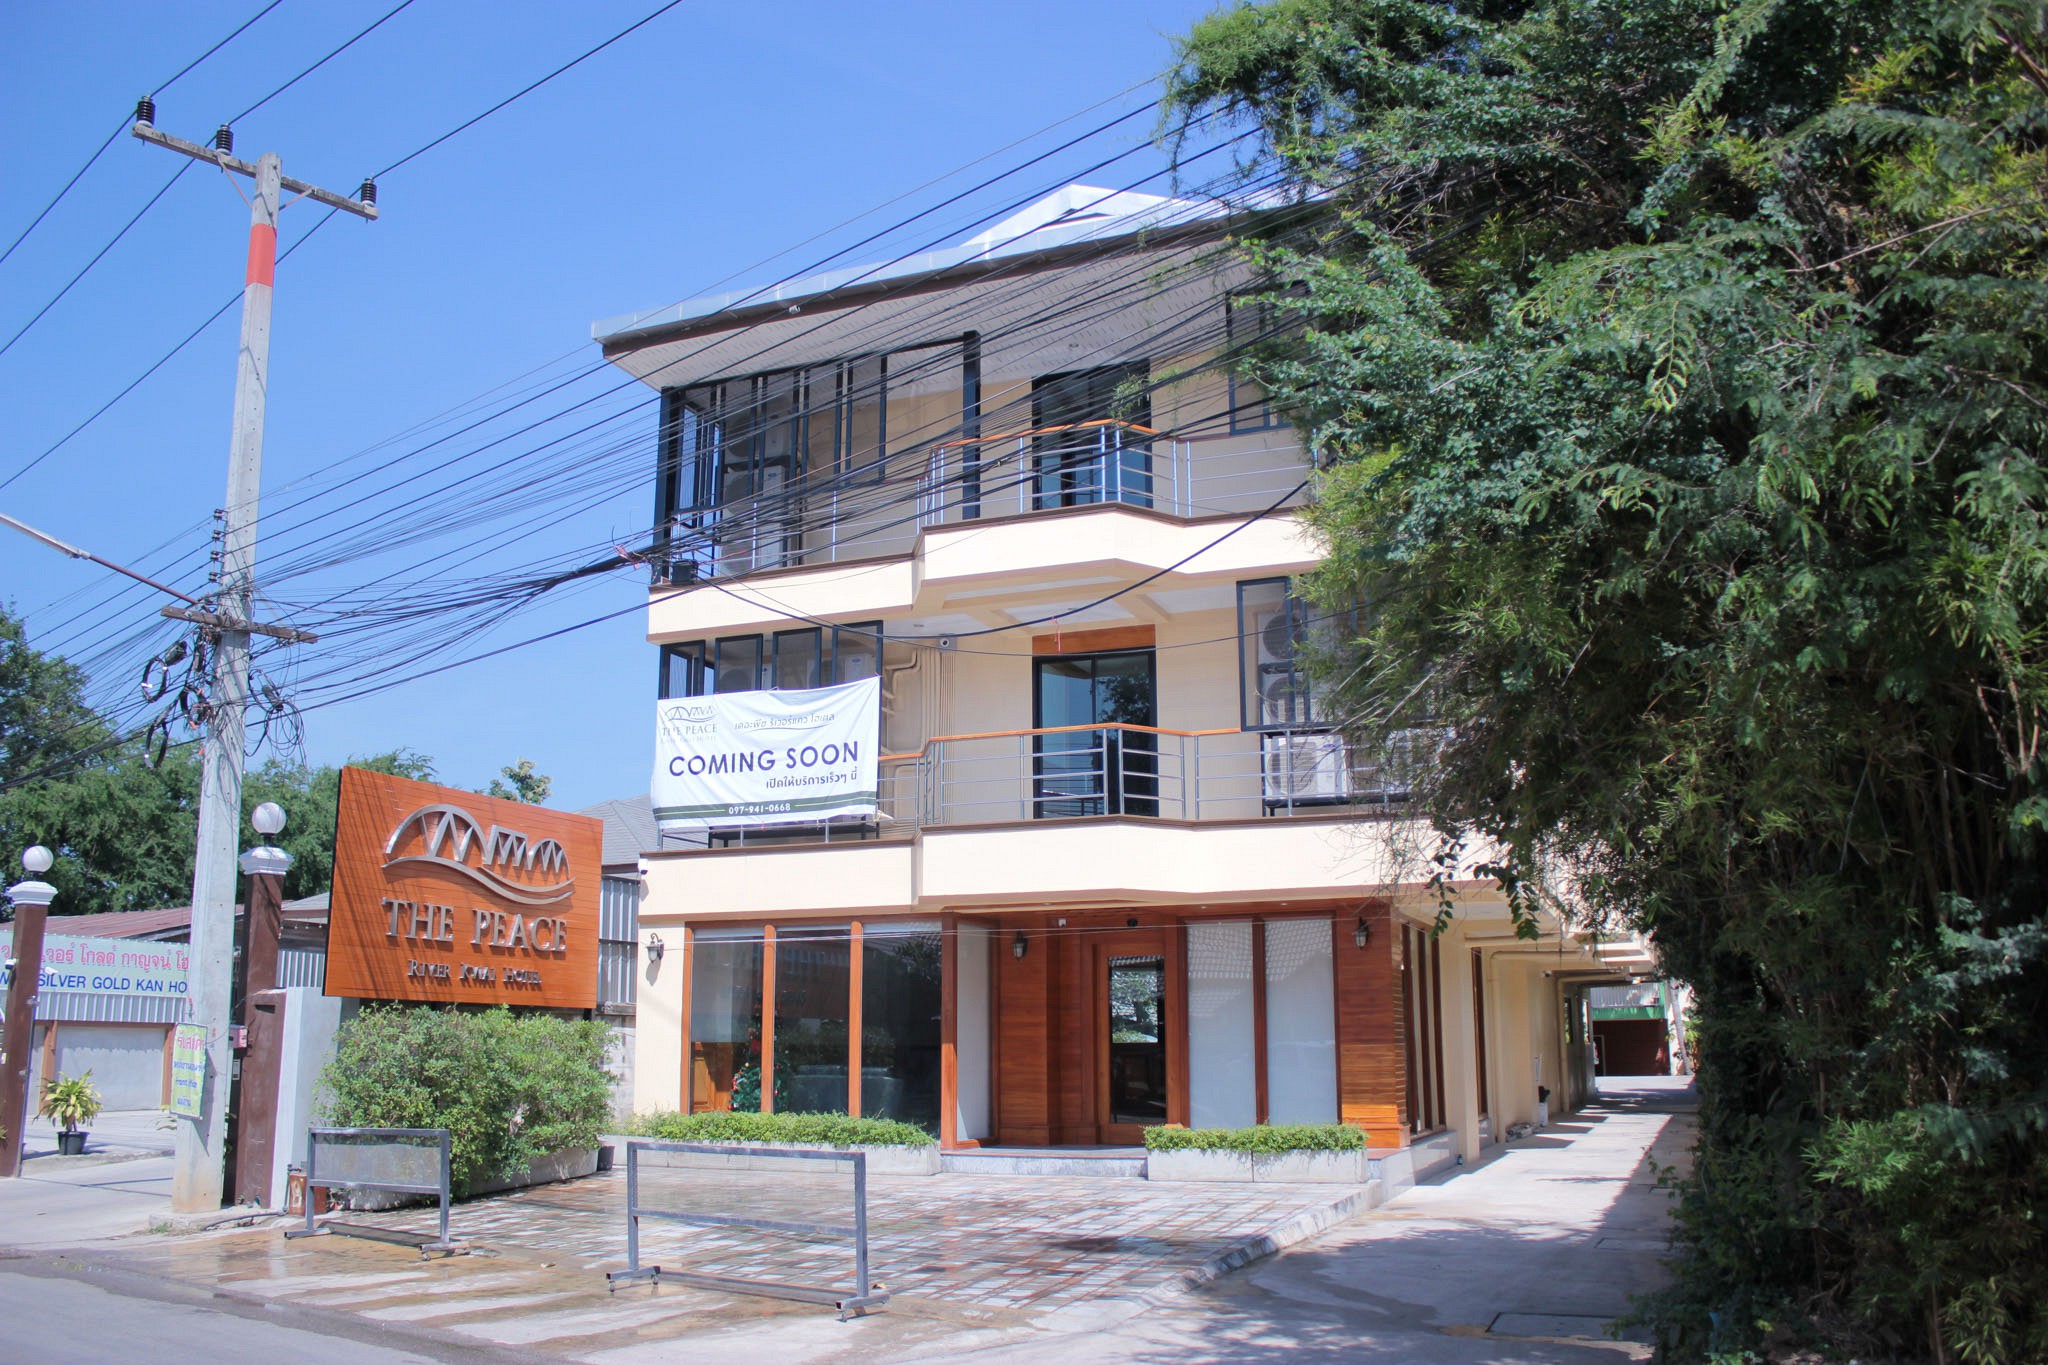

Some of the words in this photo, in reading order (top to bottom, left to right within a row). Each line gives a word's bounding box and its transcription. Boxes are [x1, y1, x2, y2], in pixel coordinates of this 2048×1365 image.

[686, 723, 718, 736] PEACE
[669, 749, 776, 777] COMING
[786, 740, 859, 769] SOON
[728, 803, 791, 815] 097-941-0668
[381, 896, 455, 942] THE
[470, 908, 567, 952] PEACE
[80, 943, 116, 966] โกลด์
[39, 973, 87, 989] SILVER
[92, 976, 131, 990] GOLD
[136, 978, 164, 992] KAN
